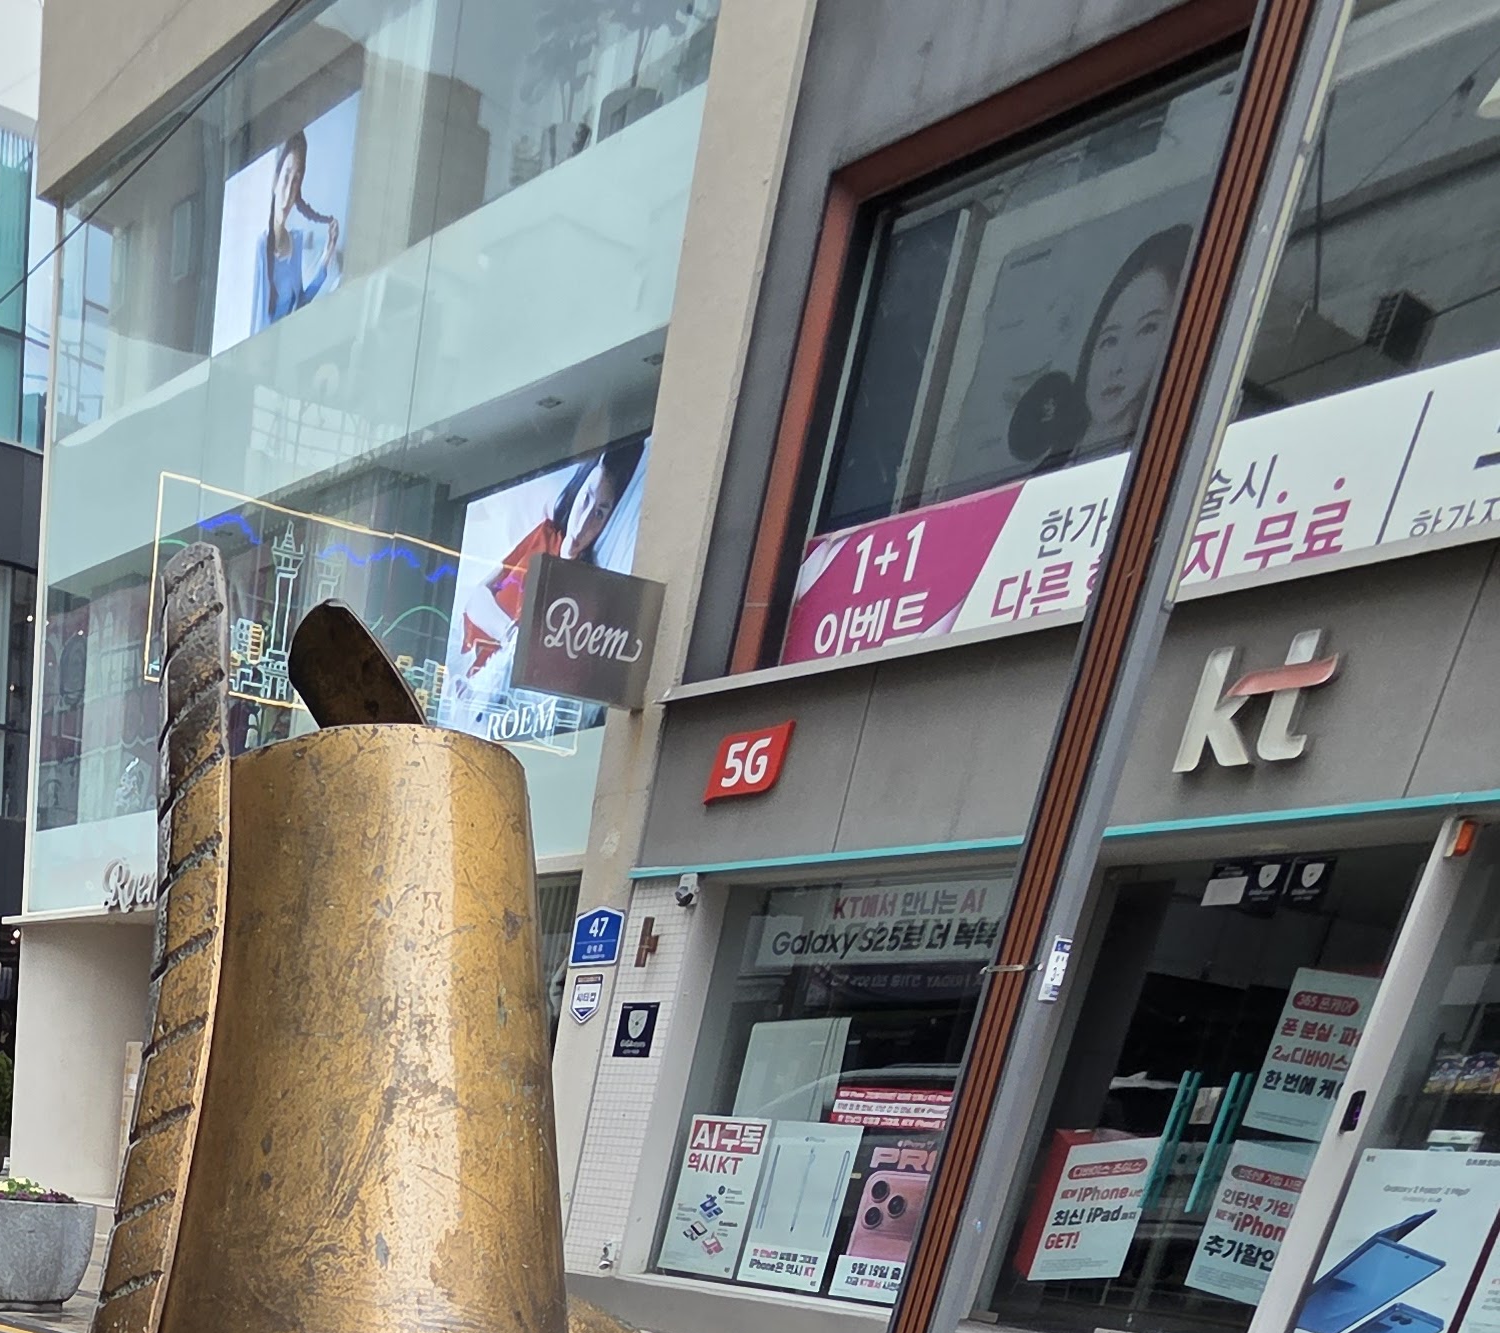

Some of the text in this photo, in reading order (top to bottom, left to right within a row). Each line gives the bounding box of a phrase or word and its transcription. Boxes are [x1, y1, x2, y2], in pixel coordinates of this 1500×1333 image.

[1243, 499, 1352, 570] 무료
[852, 520, 926, 596] 1+1
[543, 597, 644, 663] Roem
[814, 591, 929, 658] 이벤트
[486, 696, 557, 741] ROEM
[1172, 628, 1339, 774] kt
[721, 736, 772, 788] 5G
[833, 887, 988, 920] KT에서 만나는 AI
[589, 916, 610, 938] 47
[772, 927, 859, 960] Galaxy
[925, 922, 952, 950] 더
[1281, 1017, 1299, 1037] 폰
[1263, 1069, 1282, 1091] 한
[1282, 1072, 1317, 1096] 번에
[1076, 1185, 1130, 1202] iPhone
[1221, 1188, 1264, 1211] 인터넷
[1051, 1209, 1086, 1227] 최신
[1044, 1231, 1081, 1250] GET!
